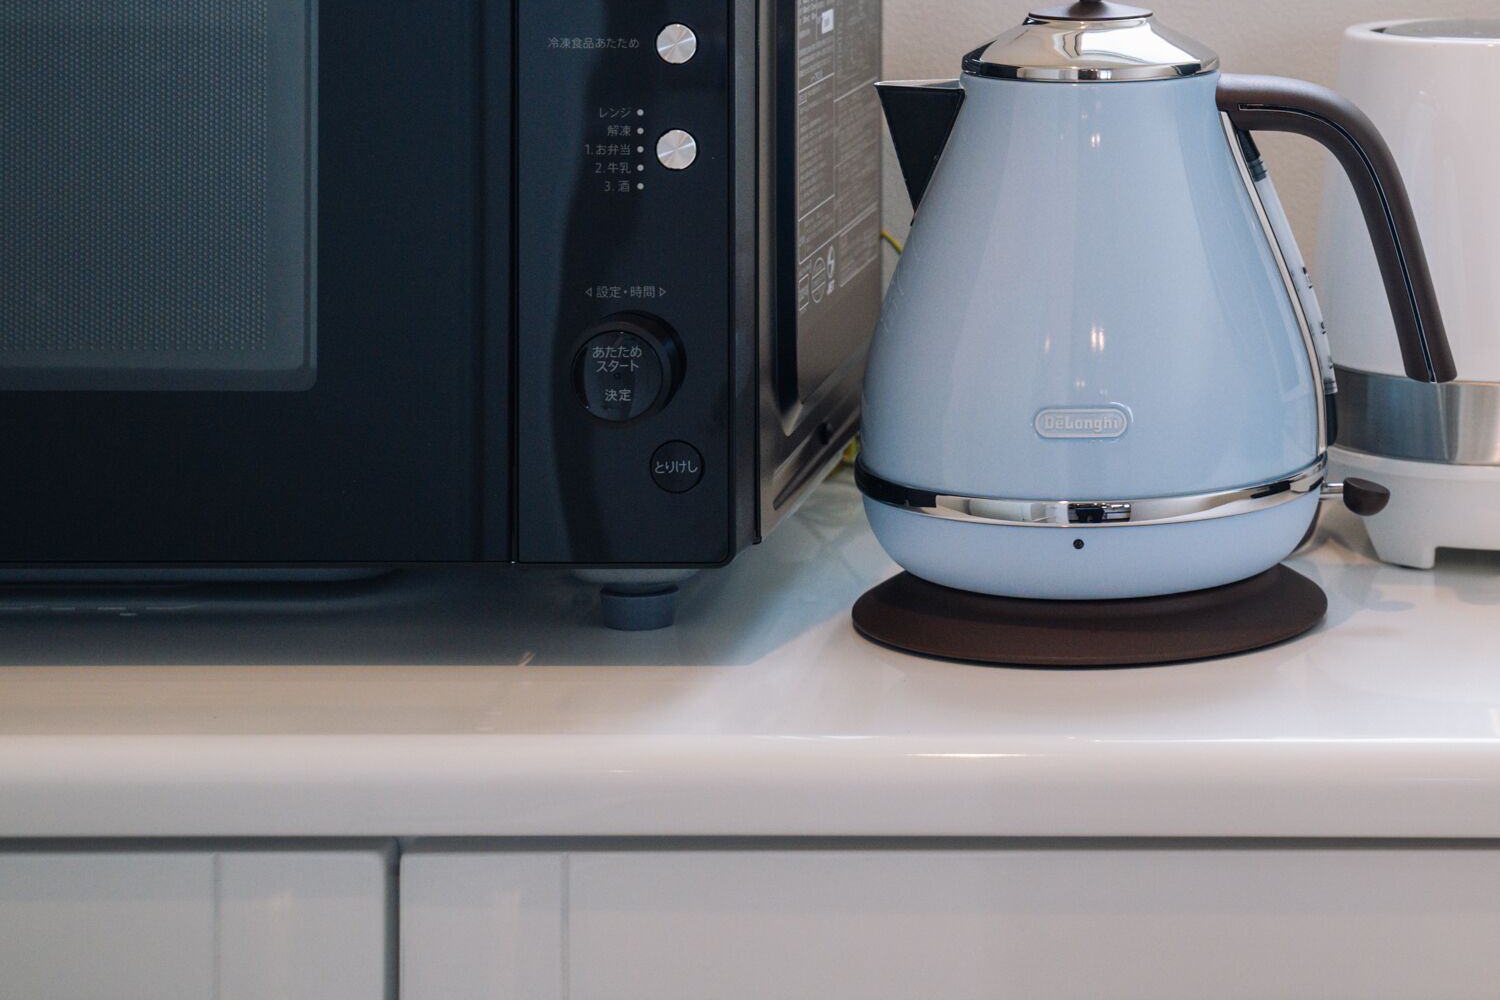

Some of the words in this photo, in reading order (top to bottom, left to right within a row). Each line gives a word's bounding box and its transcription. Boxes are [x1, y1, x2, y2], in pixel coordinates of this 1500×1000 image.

[548, 37, 640, 49] 冷凍食品あたため
[599, 107, 633, 118] レンジ
[607, 125, 632, 137] 解凍
[592, 346, 642, 359] あたため
[596, 360, 639, 373] スタート
[604, 389, 632, 402] 決定
[655, 460, 698, 473] とりけし
